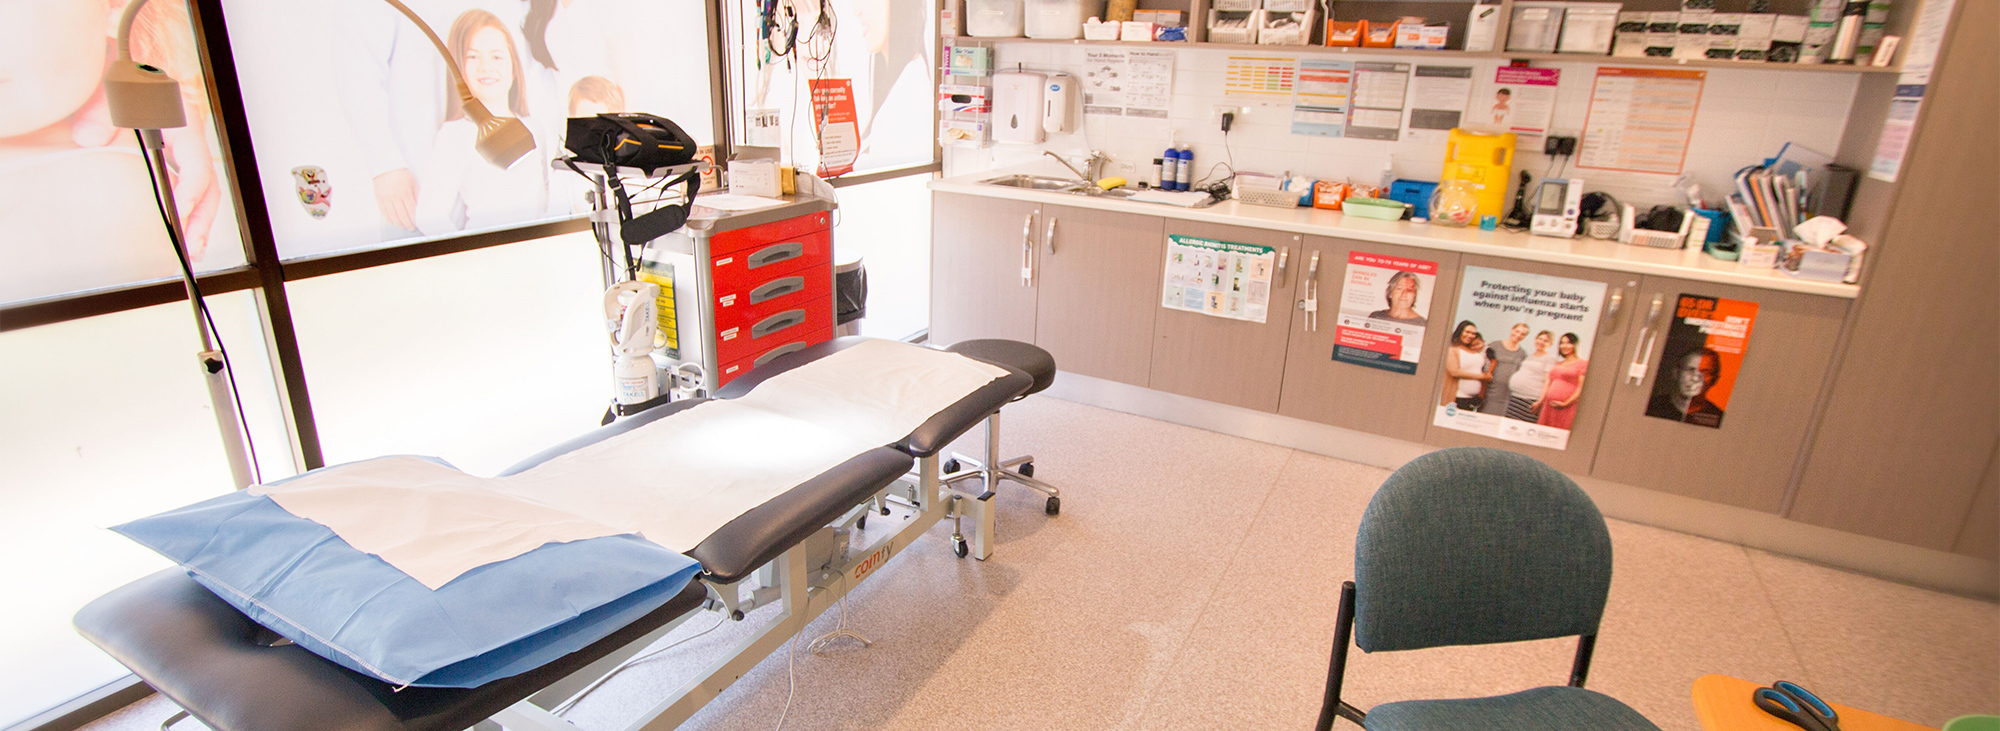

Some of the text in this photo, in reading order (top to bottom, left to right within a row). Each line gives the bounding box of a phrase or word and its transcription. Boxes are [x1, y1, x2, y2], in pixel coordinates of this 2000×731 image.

[1179, 237, 1204, 246] ALLERGIC
[1227, 244, 1263, 253] TREATMENTS
[1473, 290, 1589, 313] against influenza starts
[1481, 280, 1586, 303] Protecting your baby
[1474, 300, 1584, 322] when you're pregnant
